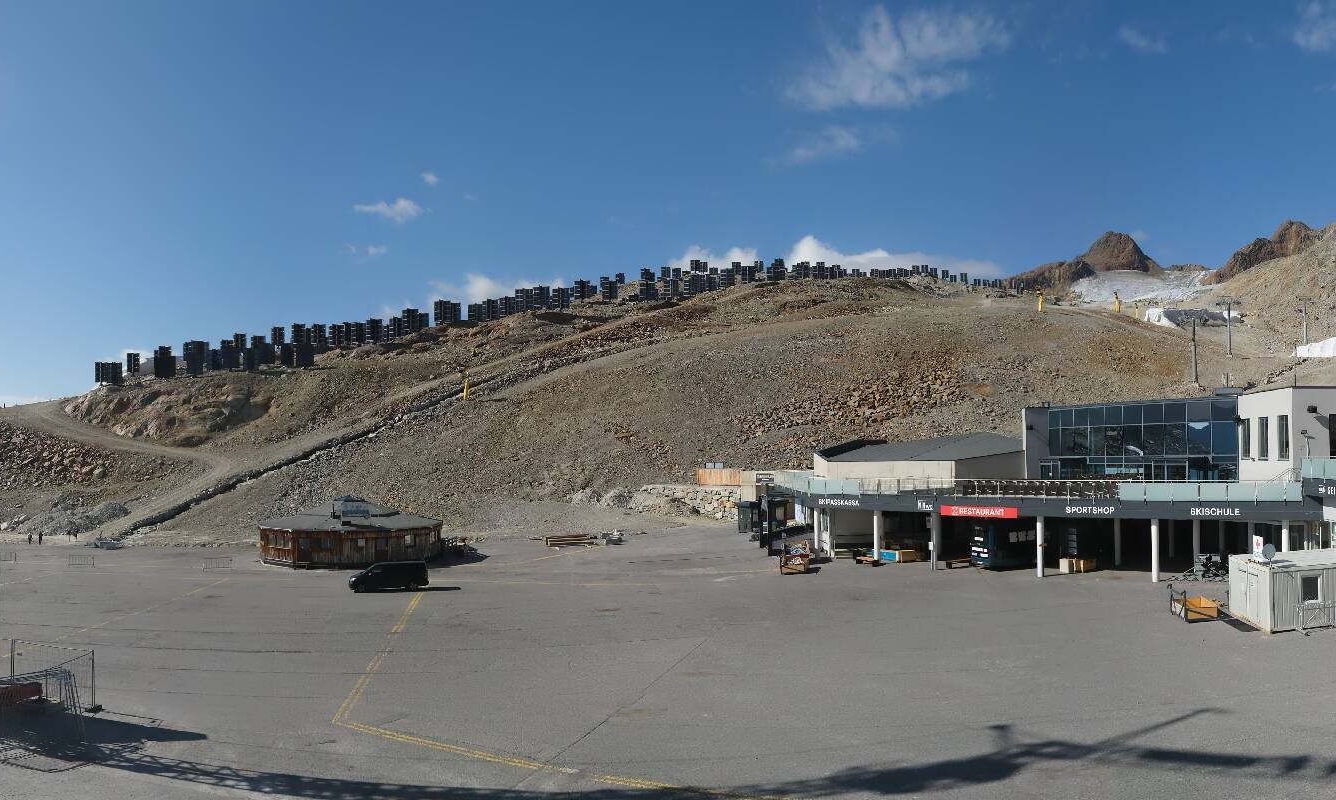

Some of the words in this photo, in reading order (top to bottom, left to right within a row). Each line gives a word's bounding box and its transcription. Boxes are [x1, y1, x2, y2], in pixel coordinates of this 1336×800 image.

[818, 498, 860, 507] SKIPASSKASSA
[959, 507, 1005, 516] RESTAURANT
[1065, 506, 1115, 515] SPORTSHOP
[1190, 507, 1241, 516] SKISCHULE
